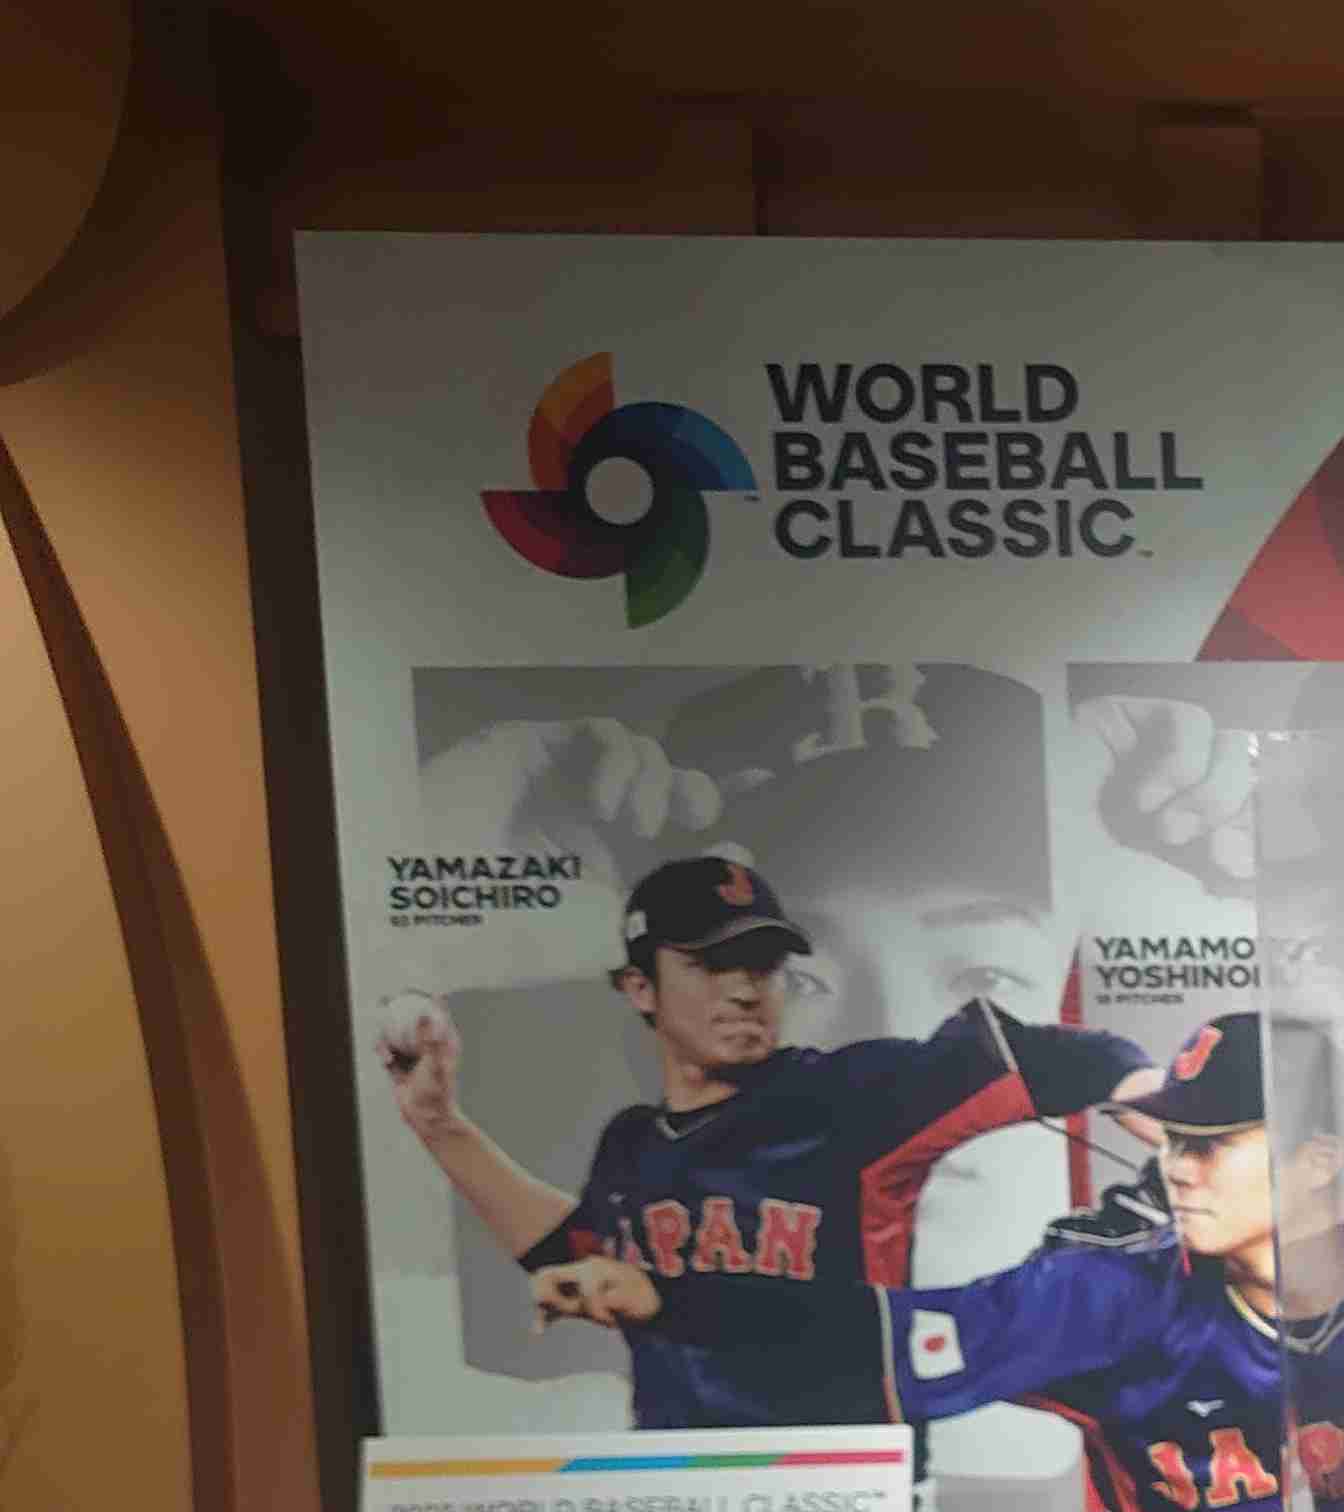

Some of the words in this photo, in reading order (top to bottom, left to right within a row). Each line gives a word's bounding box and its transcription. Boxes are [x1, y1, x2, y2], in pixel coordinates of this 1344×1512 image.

[765, 364, 1079, 424] WORLD
[774, 431, 1204, 491] BASEBALL
[774, 497, 1136, 559] CLASSIC
[386, 855, 582, 881] YAMAZAKI
[389, 884, 562, 910] SOICHIRO
